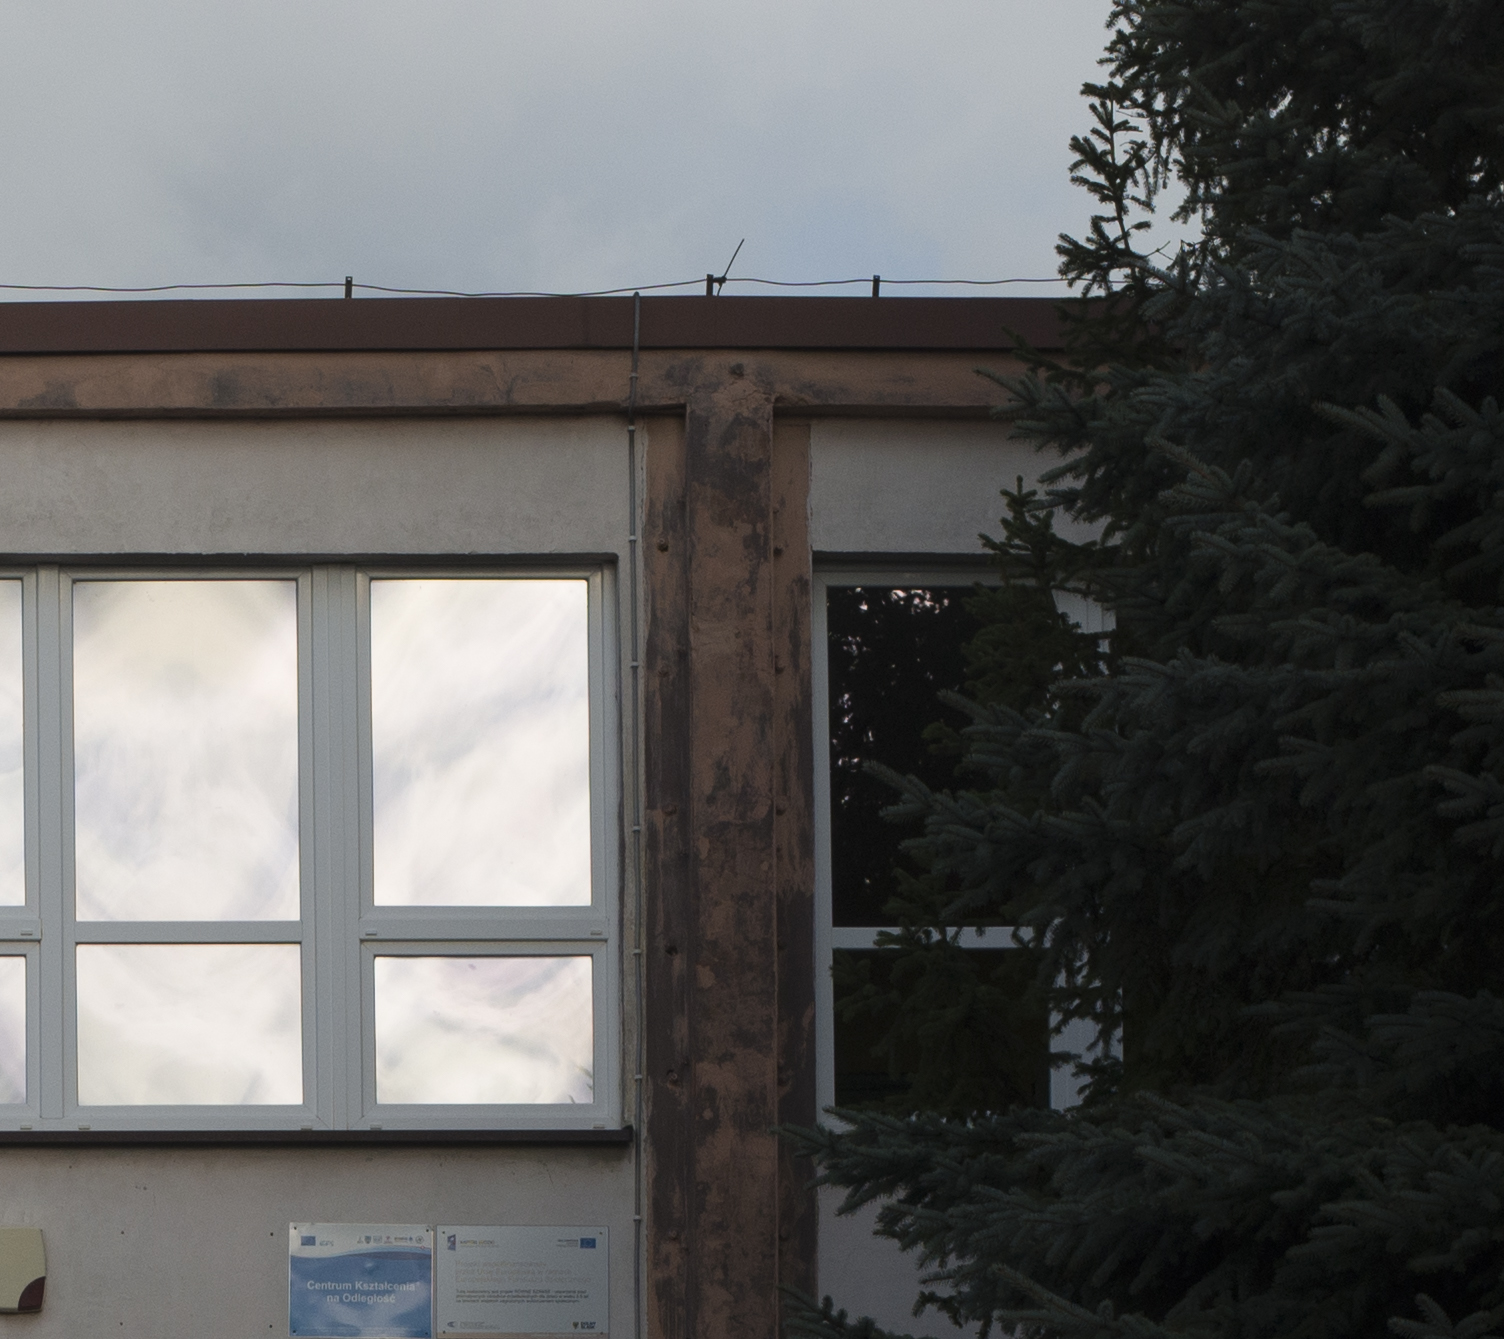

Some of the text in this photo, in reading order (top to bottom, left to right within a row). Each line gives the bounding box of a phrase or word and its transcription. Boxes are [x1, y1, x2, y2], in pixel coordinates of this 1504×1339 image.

[307, 1280, 416, 1291] Centrum Kształcenia
[326, 1293, 396, 1304] na Odległość
